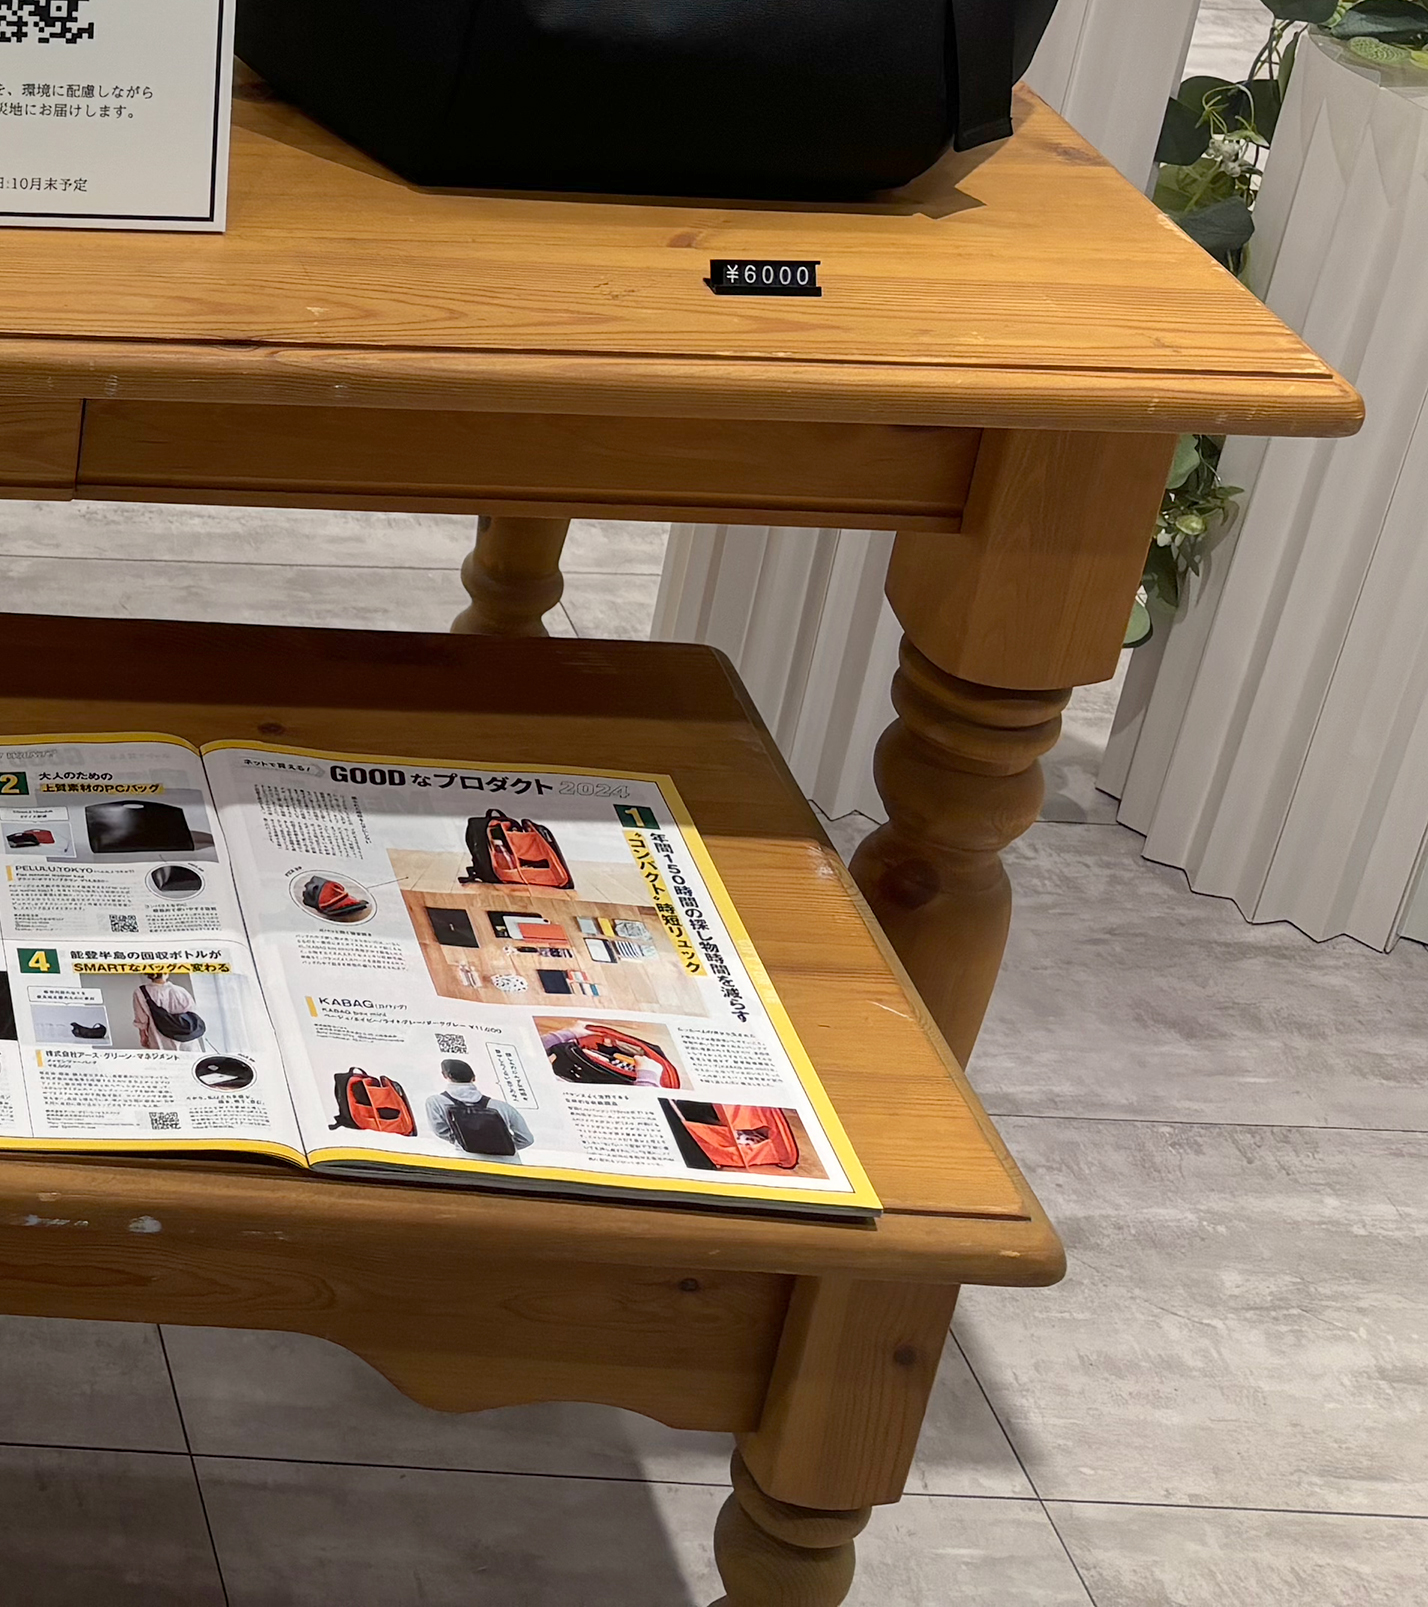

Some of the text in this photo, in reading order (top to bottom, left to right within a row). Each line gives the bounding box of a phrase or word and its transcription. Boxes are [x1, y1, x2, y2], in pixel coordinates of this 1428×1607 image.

[726, 264, 809, 285] ¥6000
[0, 774, 20, 793] 2
[39, 772, 113, 780] 大人のための
[559, 781, 631, 798] 2024
[625, 807, 644, 827] 1
[28, 951, 51, 971] 4
[319, 998, 377, 1011] KABAG
